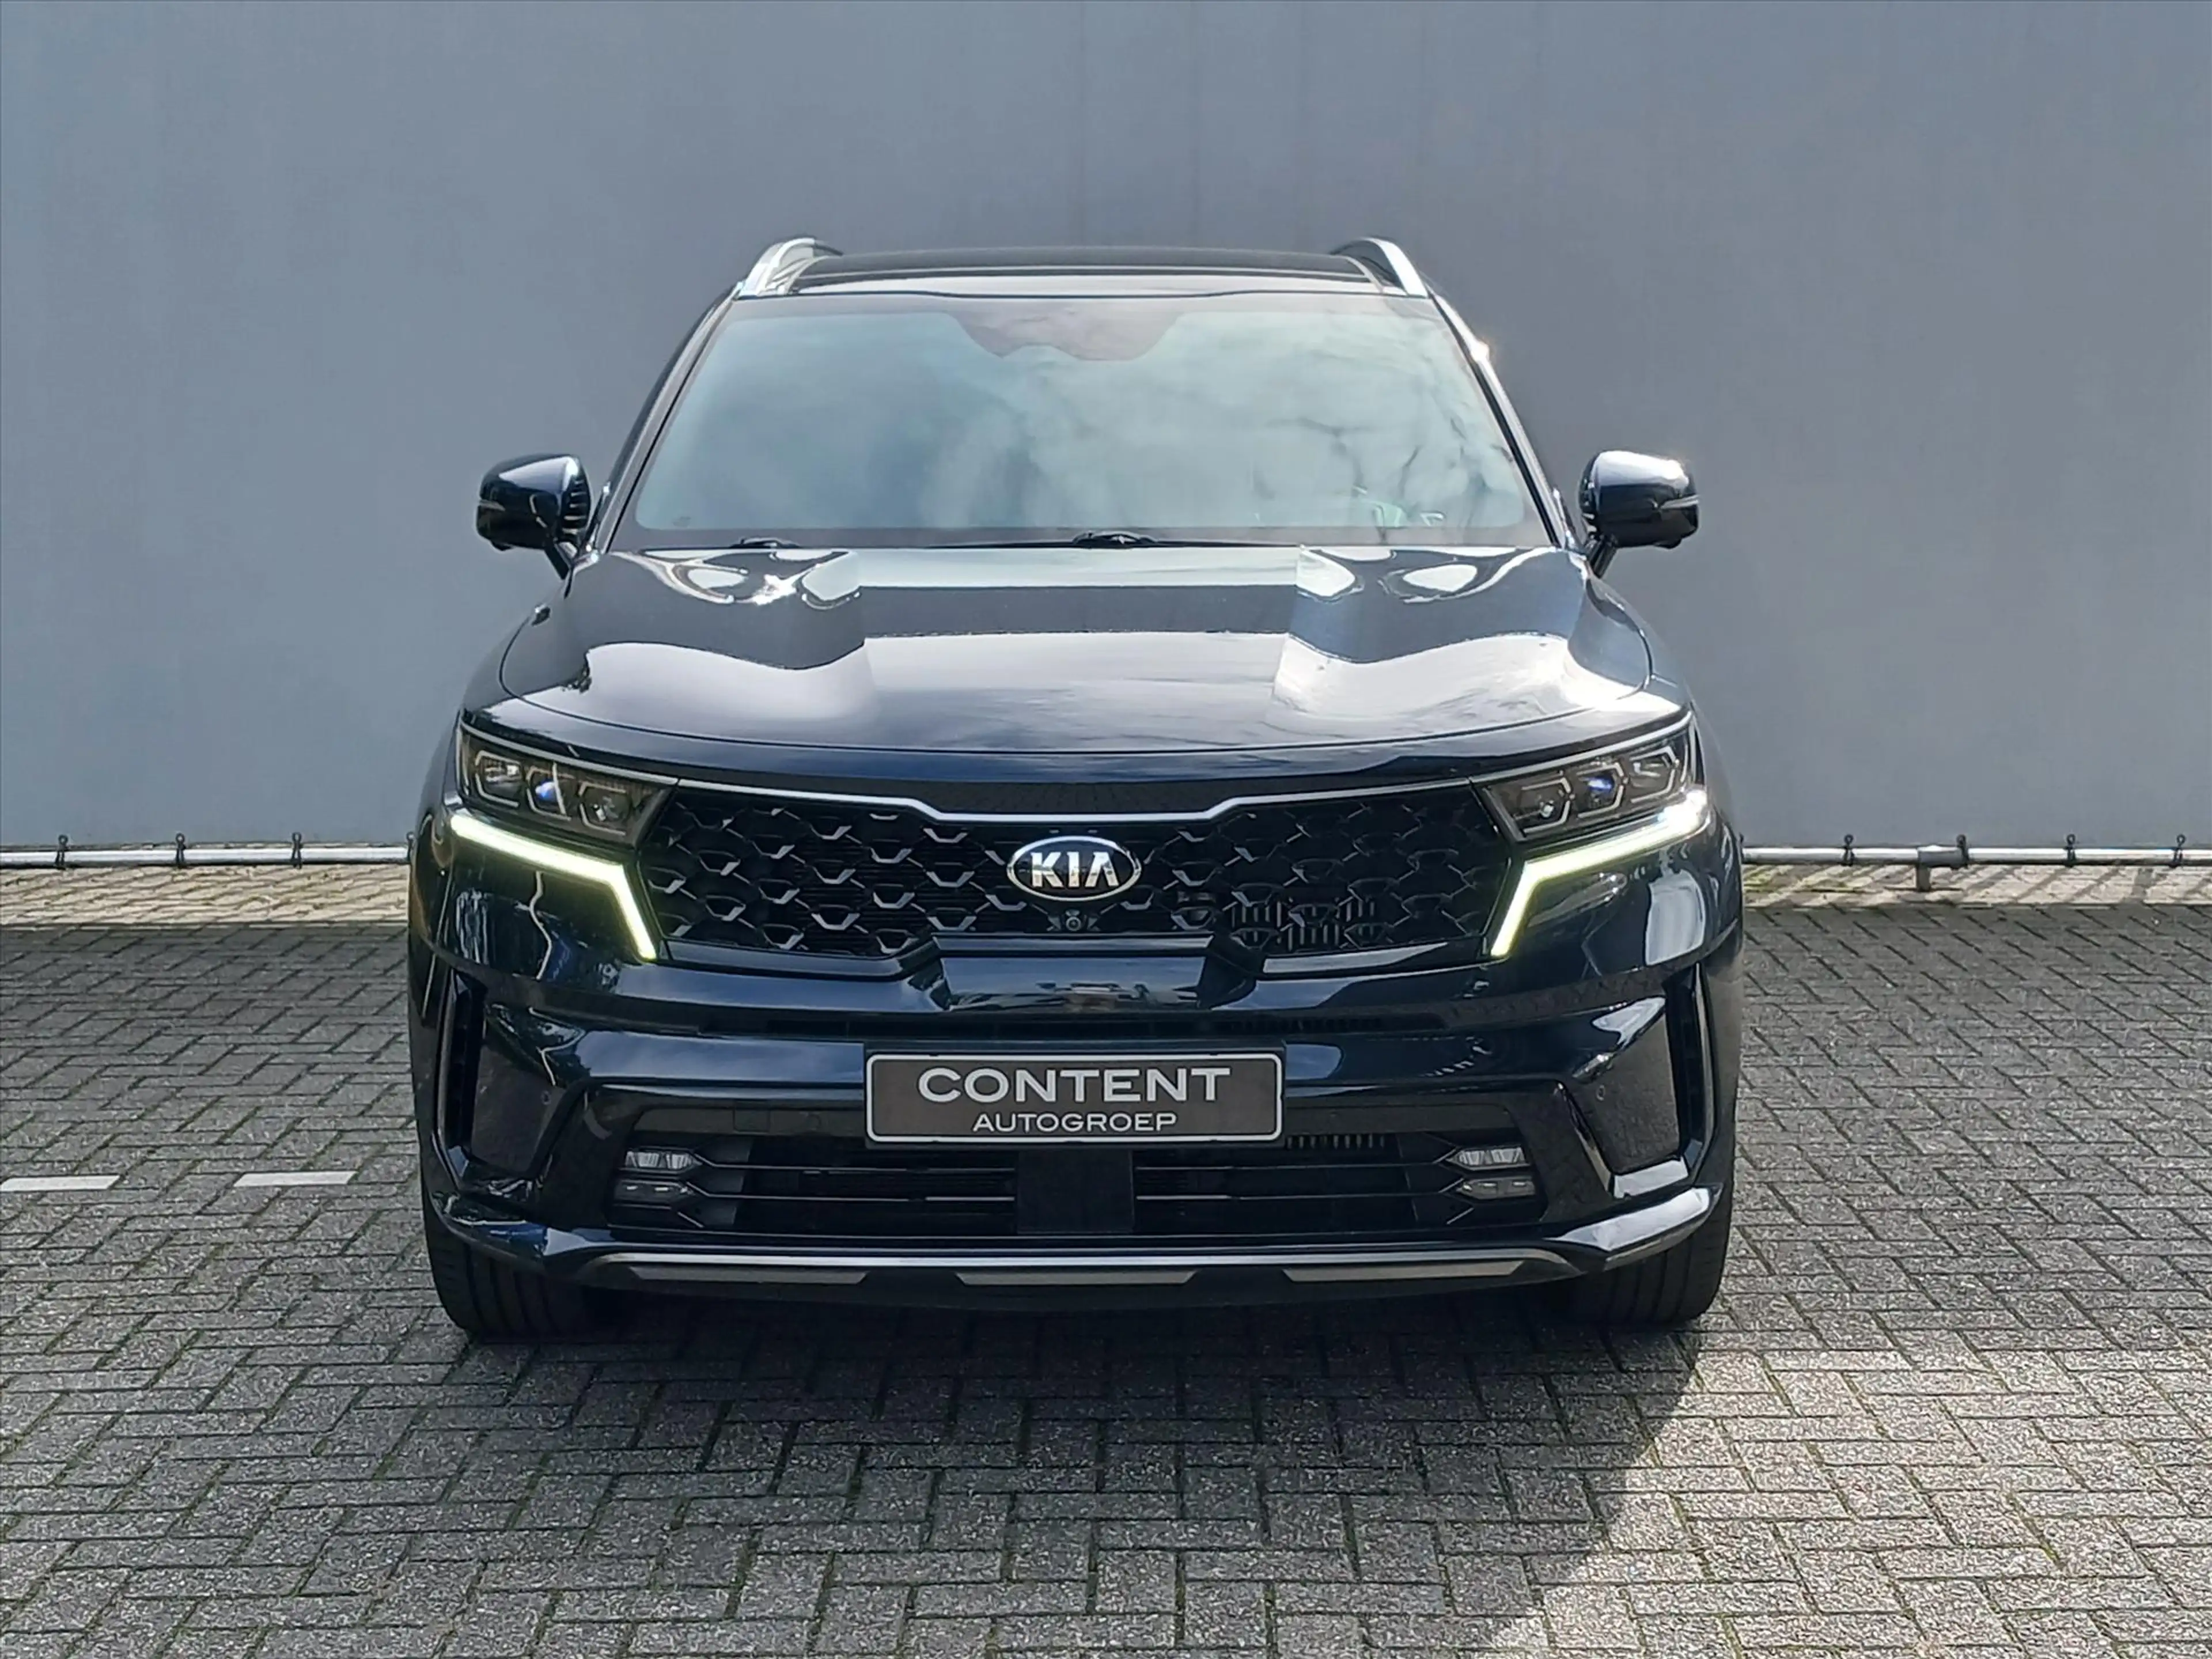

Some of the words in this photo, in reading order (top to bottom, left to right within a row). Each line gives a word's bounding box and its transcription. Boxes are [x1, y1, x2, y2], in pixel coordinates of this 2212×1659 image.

[1030, 851, 1119, 888] KIA
[918, 1067, 1230, 1103] CONTENT
[972, 1112, 1177, 1133] AUTOGROEP
